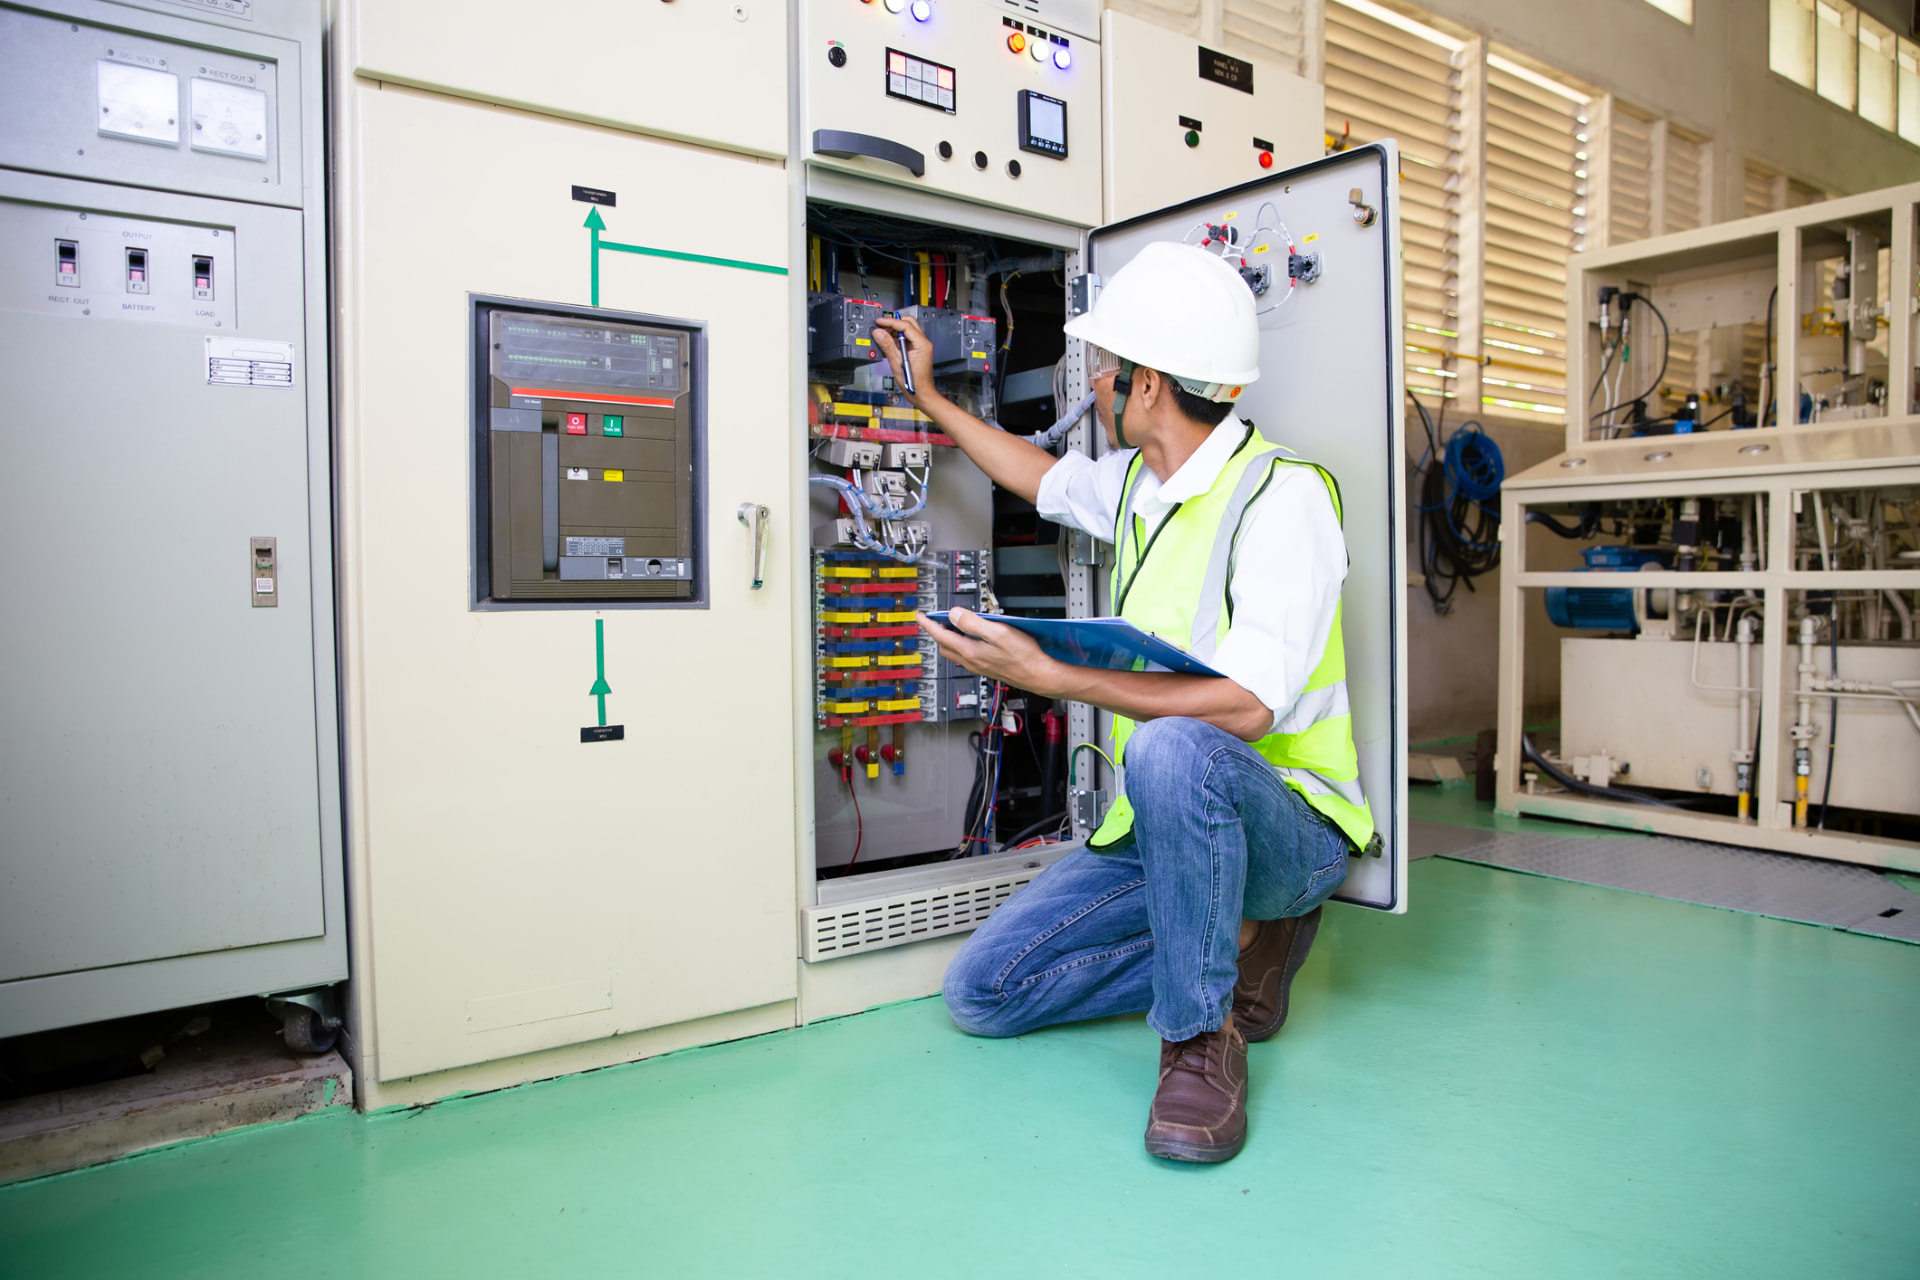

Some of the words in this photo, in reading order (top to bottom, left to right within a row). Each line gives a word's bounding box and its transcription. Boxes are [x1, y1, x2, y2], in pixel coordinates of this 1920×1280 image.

[1010, 19, 1016, 28] R
[1034, 28, 1040, 37] S
[1057, 36, 1062, 45] T
[136, 54, 156, 65] VOLT
[209, 69, 230, 79] RECT
[230, 72, 246, 83] OUT
[122, 230, 152, 240] OUTPUT
[73, 297, 90, 305] OUT
[121, 303, 156, 312] BATTERY
[195, 309, 215, 318] LOAD
